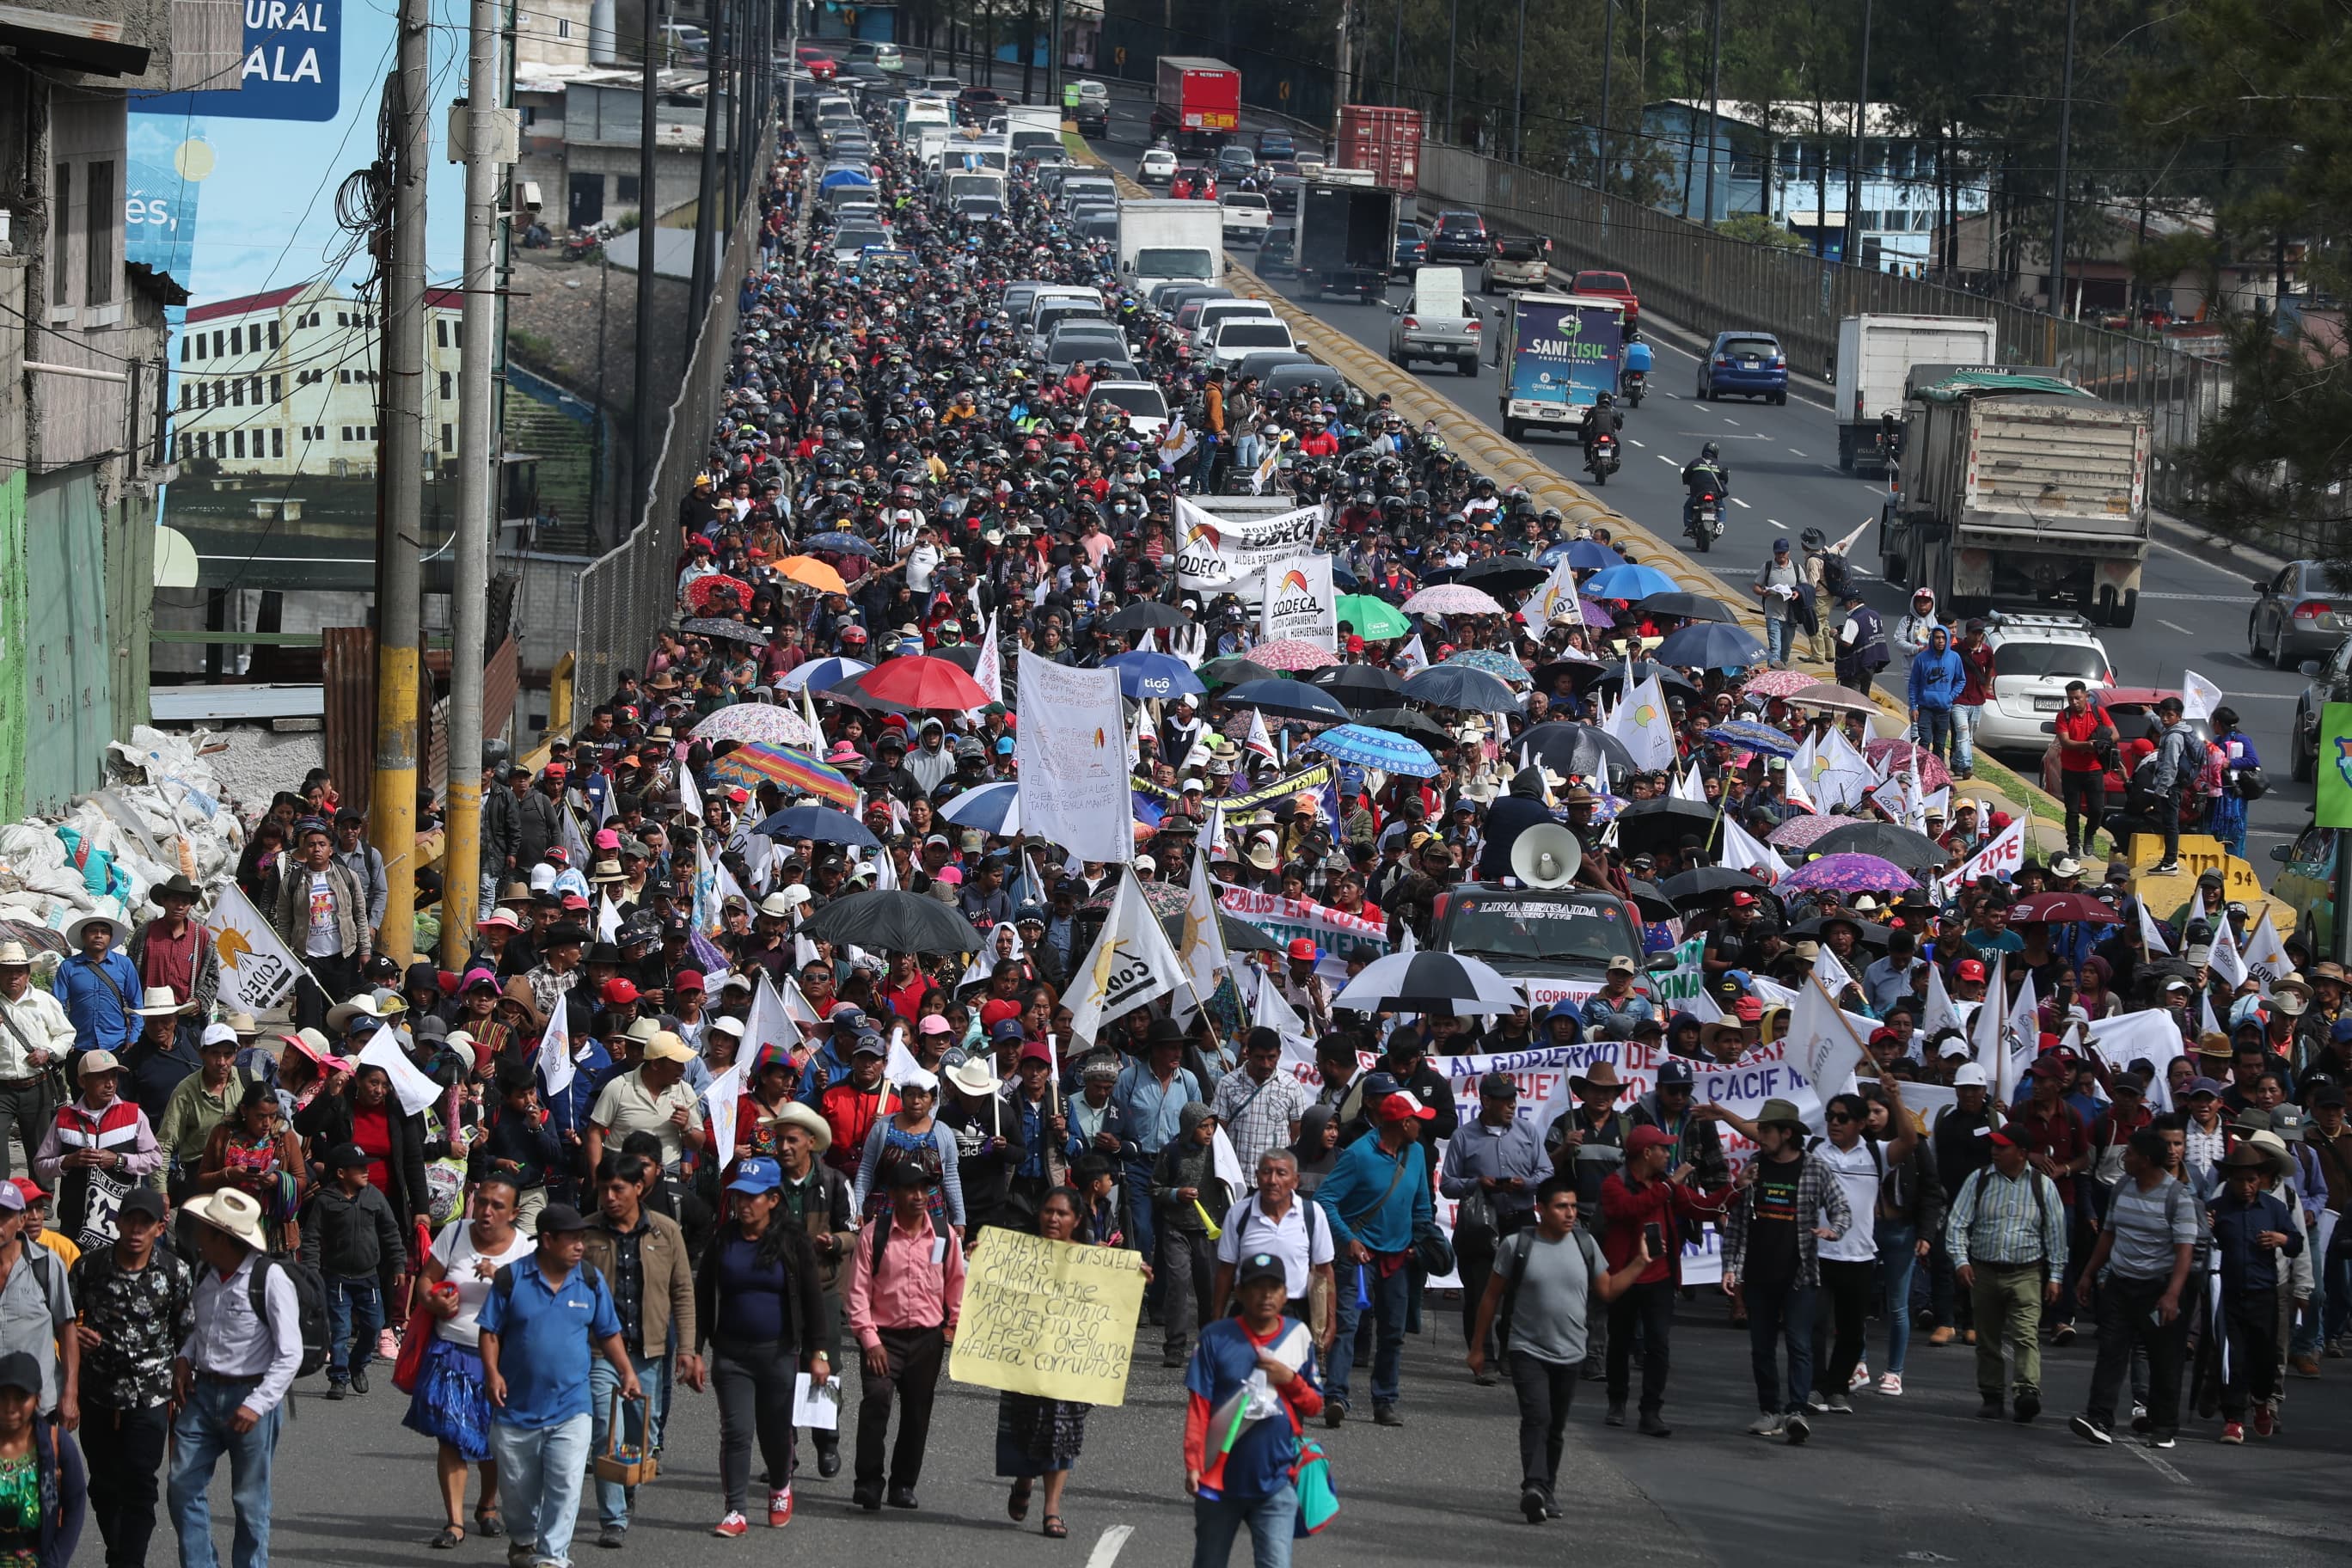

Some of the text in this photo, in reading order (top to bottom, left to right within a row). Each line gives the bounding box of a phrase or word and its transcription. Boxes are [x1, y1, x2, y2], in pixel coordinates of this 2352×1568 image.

[246, 0, 327, 32] URAL
[242, 45, 322, 83] ALA
[1539, 356, 1595, 364] PROFESSIONAL
[1241, 512, 1315, 533] MOVIMIENTO
[1234, 554, 1256, 565] ALDEA
[1272, 597, 1318, 615] CODECA
[1291, 627, 1333, 638] HUEHUETENANGO
[1256, 767, 1329, 799] CAMPESINO
[1479, 902, 1518, 913] LINA
[1547, 912, 1572, 921] VIVE
[1451, 1057, 1483, 1076] AL
[1491, 1043, 1619, 1073] GOBIERNO
[1625, 1043, 1660, 1070] DE
[1707, 1069, 1779, 1101] CACIF
[982, 1228, 1053, 1259] AFUERA
[983, 1246, 1053, 1275] PORRAS
